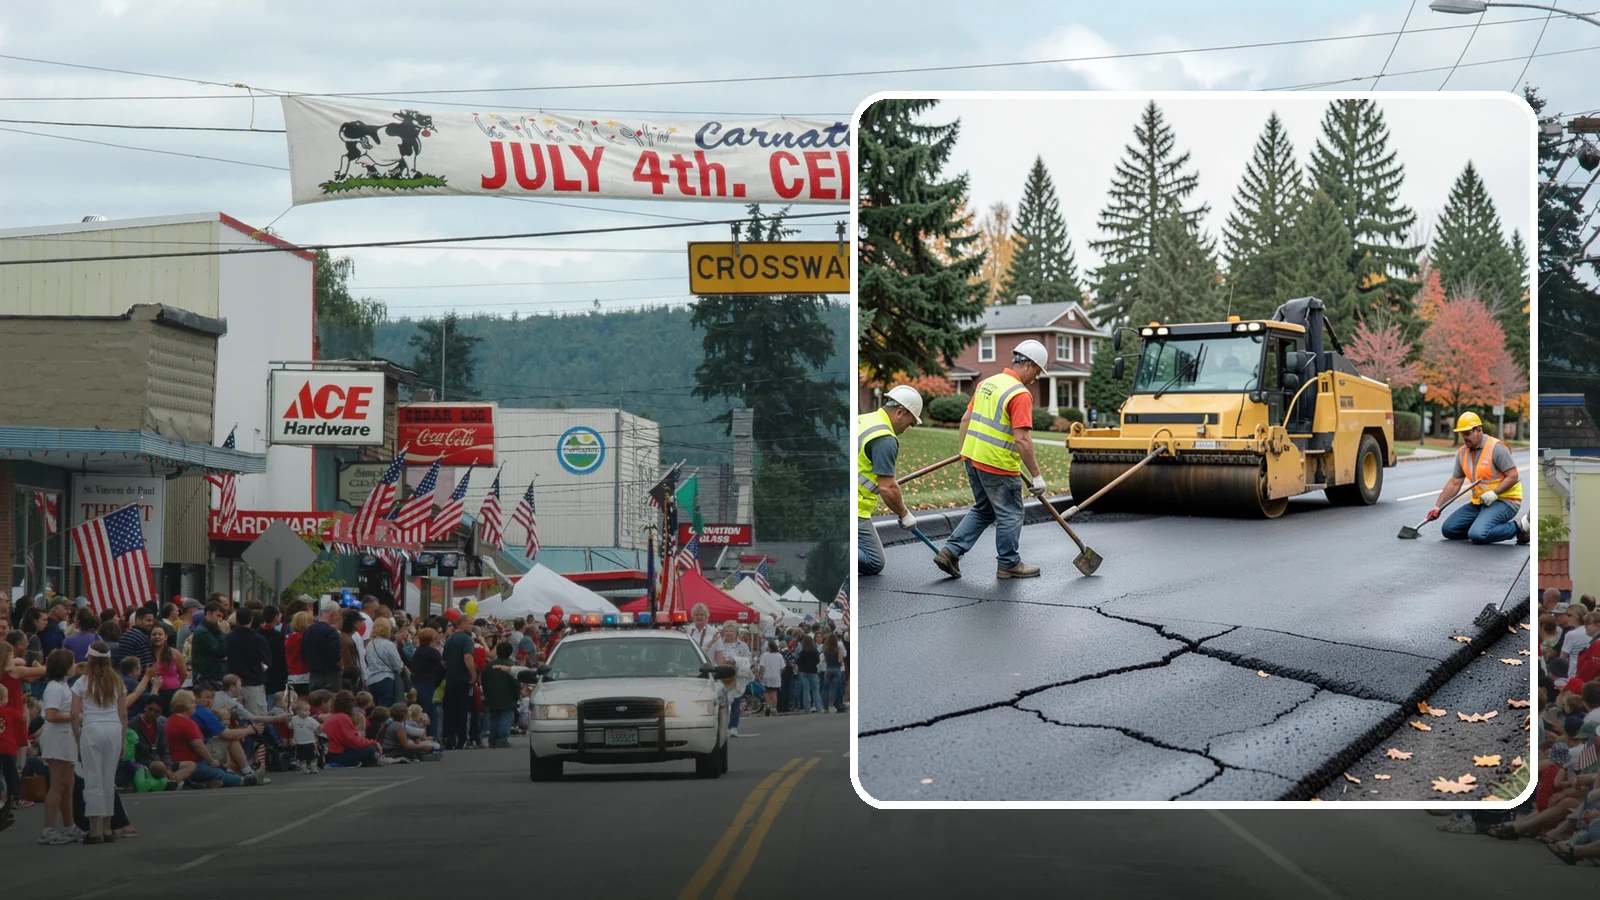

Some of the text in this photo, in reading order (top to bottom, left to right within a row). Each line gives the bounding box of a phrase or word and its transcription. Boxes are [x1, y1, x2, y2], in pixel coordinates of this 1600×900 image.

[695, 121, 850, 149] Carnat
[481, 141, 605, 192] JULY
[632, 150, 746, 197] 4th.
[697, 254, 850, 280] CROSSWA
[282, 380, 373, 419] ACE
[406, 409, 453, 422] CEDAR
[283, 421, 370, 436] Hardware
[416, 428, 477, 446] Coca-Cola
[95, 485, 124, 495] Vincent
[126, 486, 135, 495] de
[138, 486, 155, 495] Paul
[212, 516, 331, 535] HARDARE
[688, 526, 741, 535] CRNATION
[699, 535, 730, 543] GLASS
